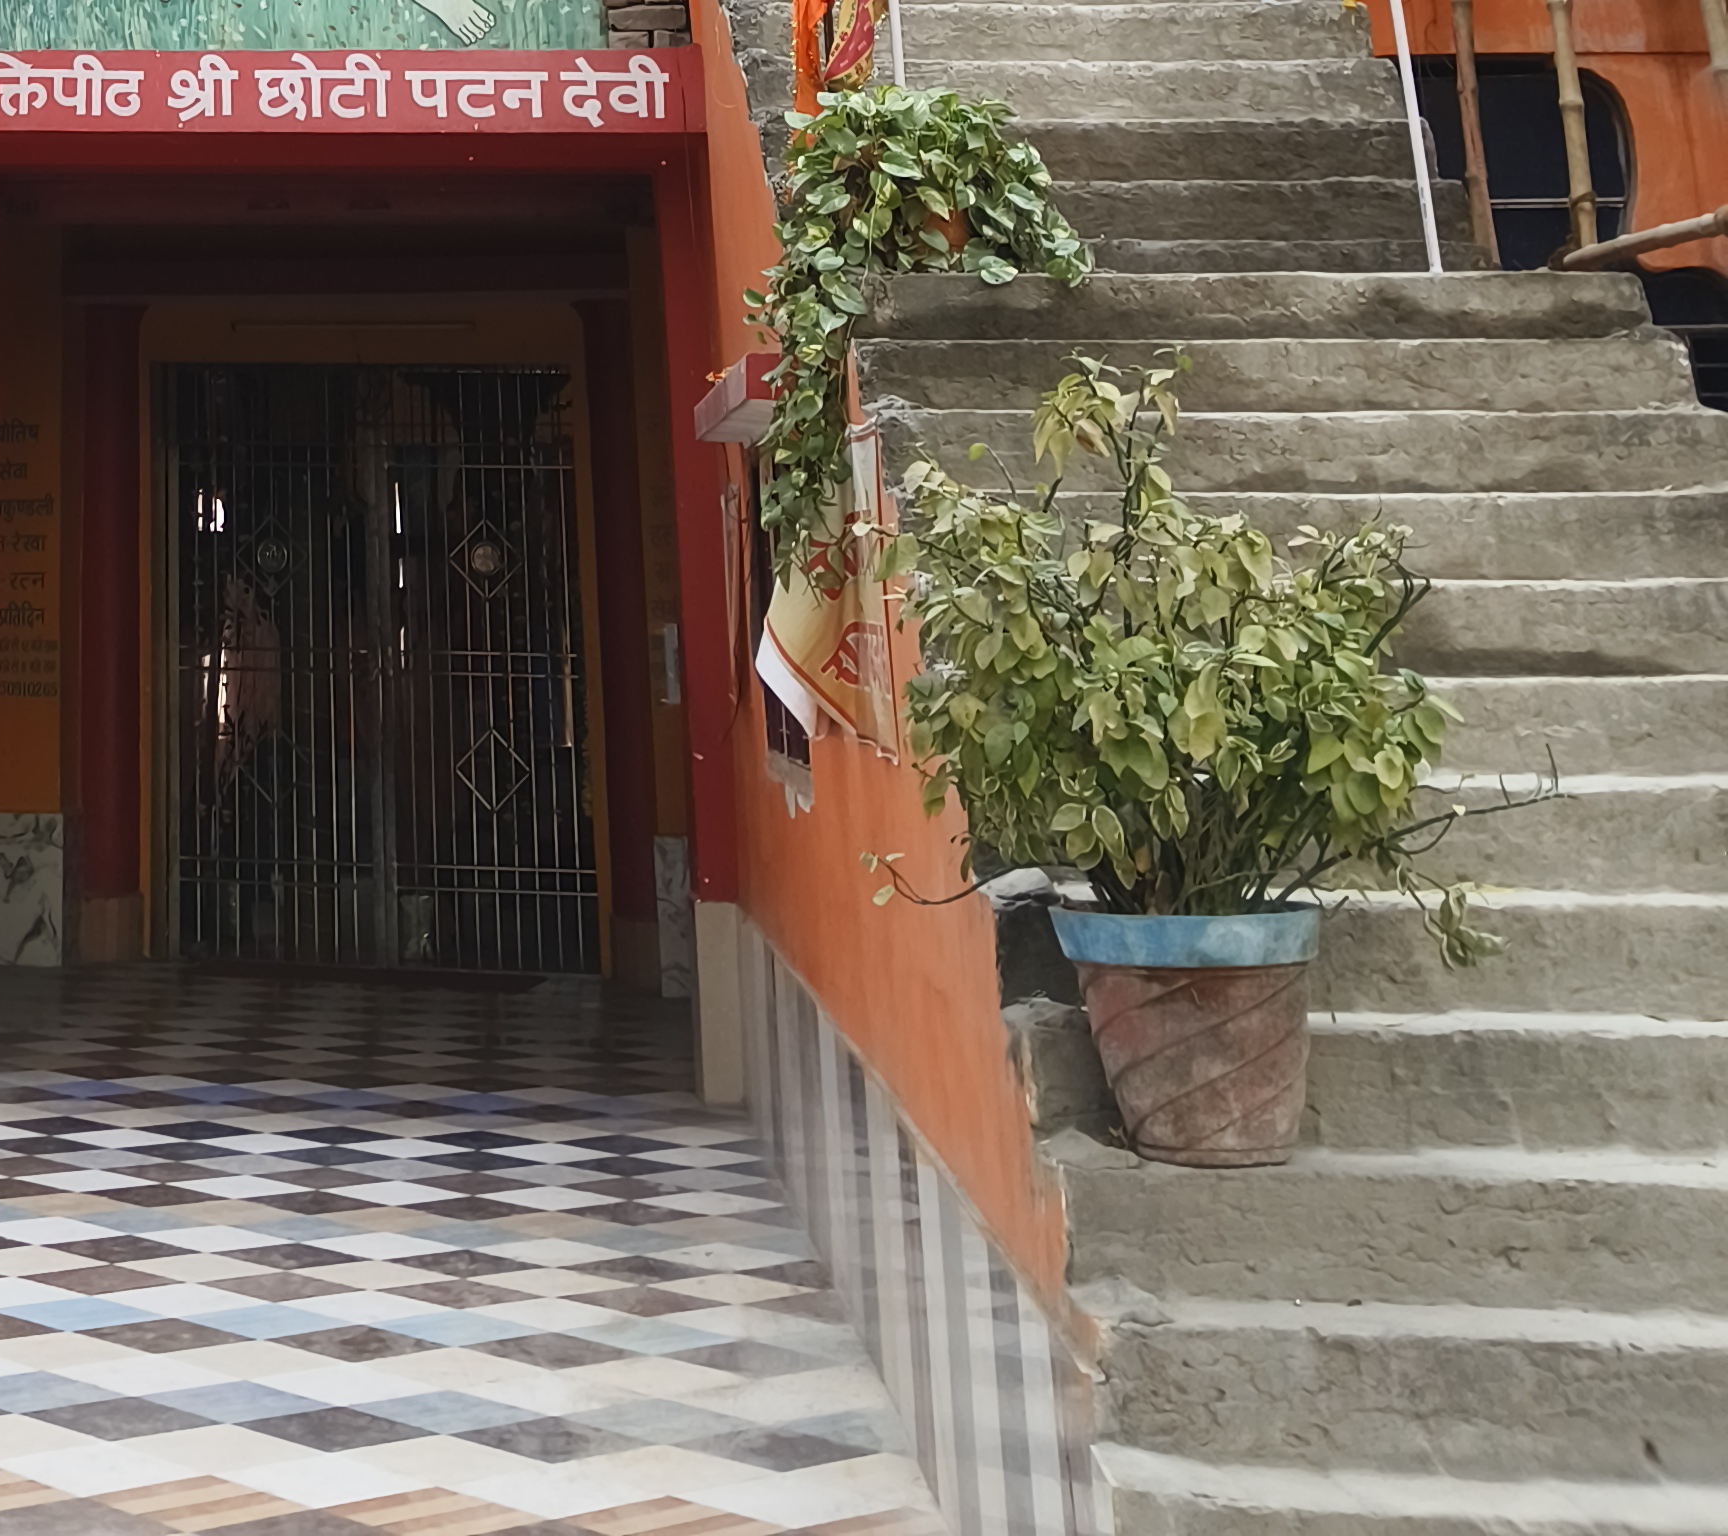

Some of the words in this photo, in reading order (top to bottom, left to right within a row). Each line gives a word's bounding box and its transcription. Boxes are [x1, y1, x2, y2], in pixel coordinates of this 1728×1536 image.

[168, 53, 239, 122] श्री
[255, 52, 391, 122] छोटी
[404, 70, 548, 118] पटन
[560, 56, 669, 128] देवी
